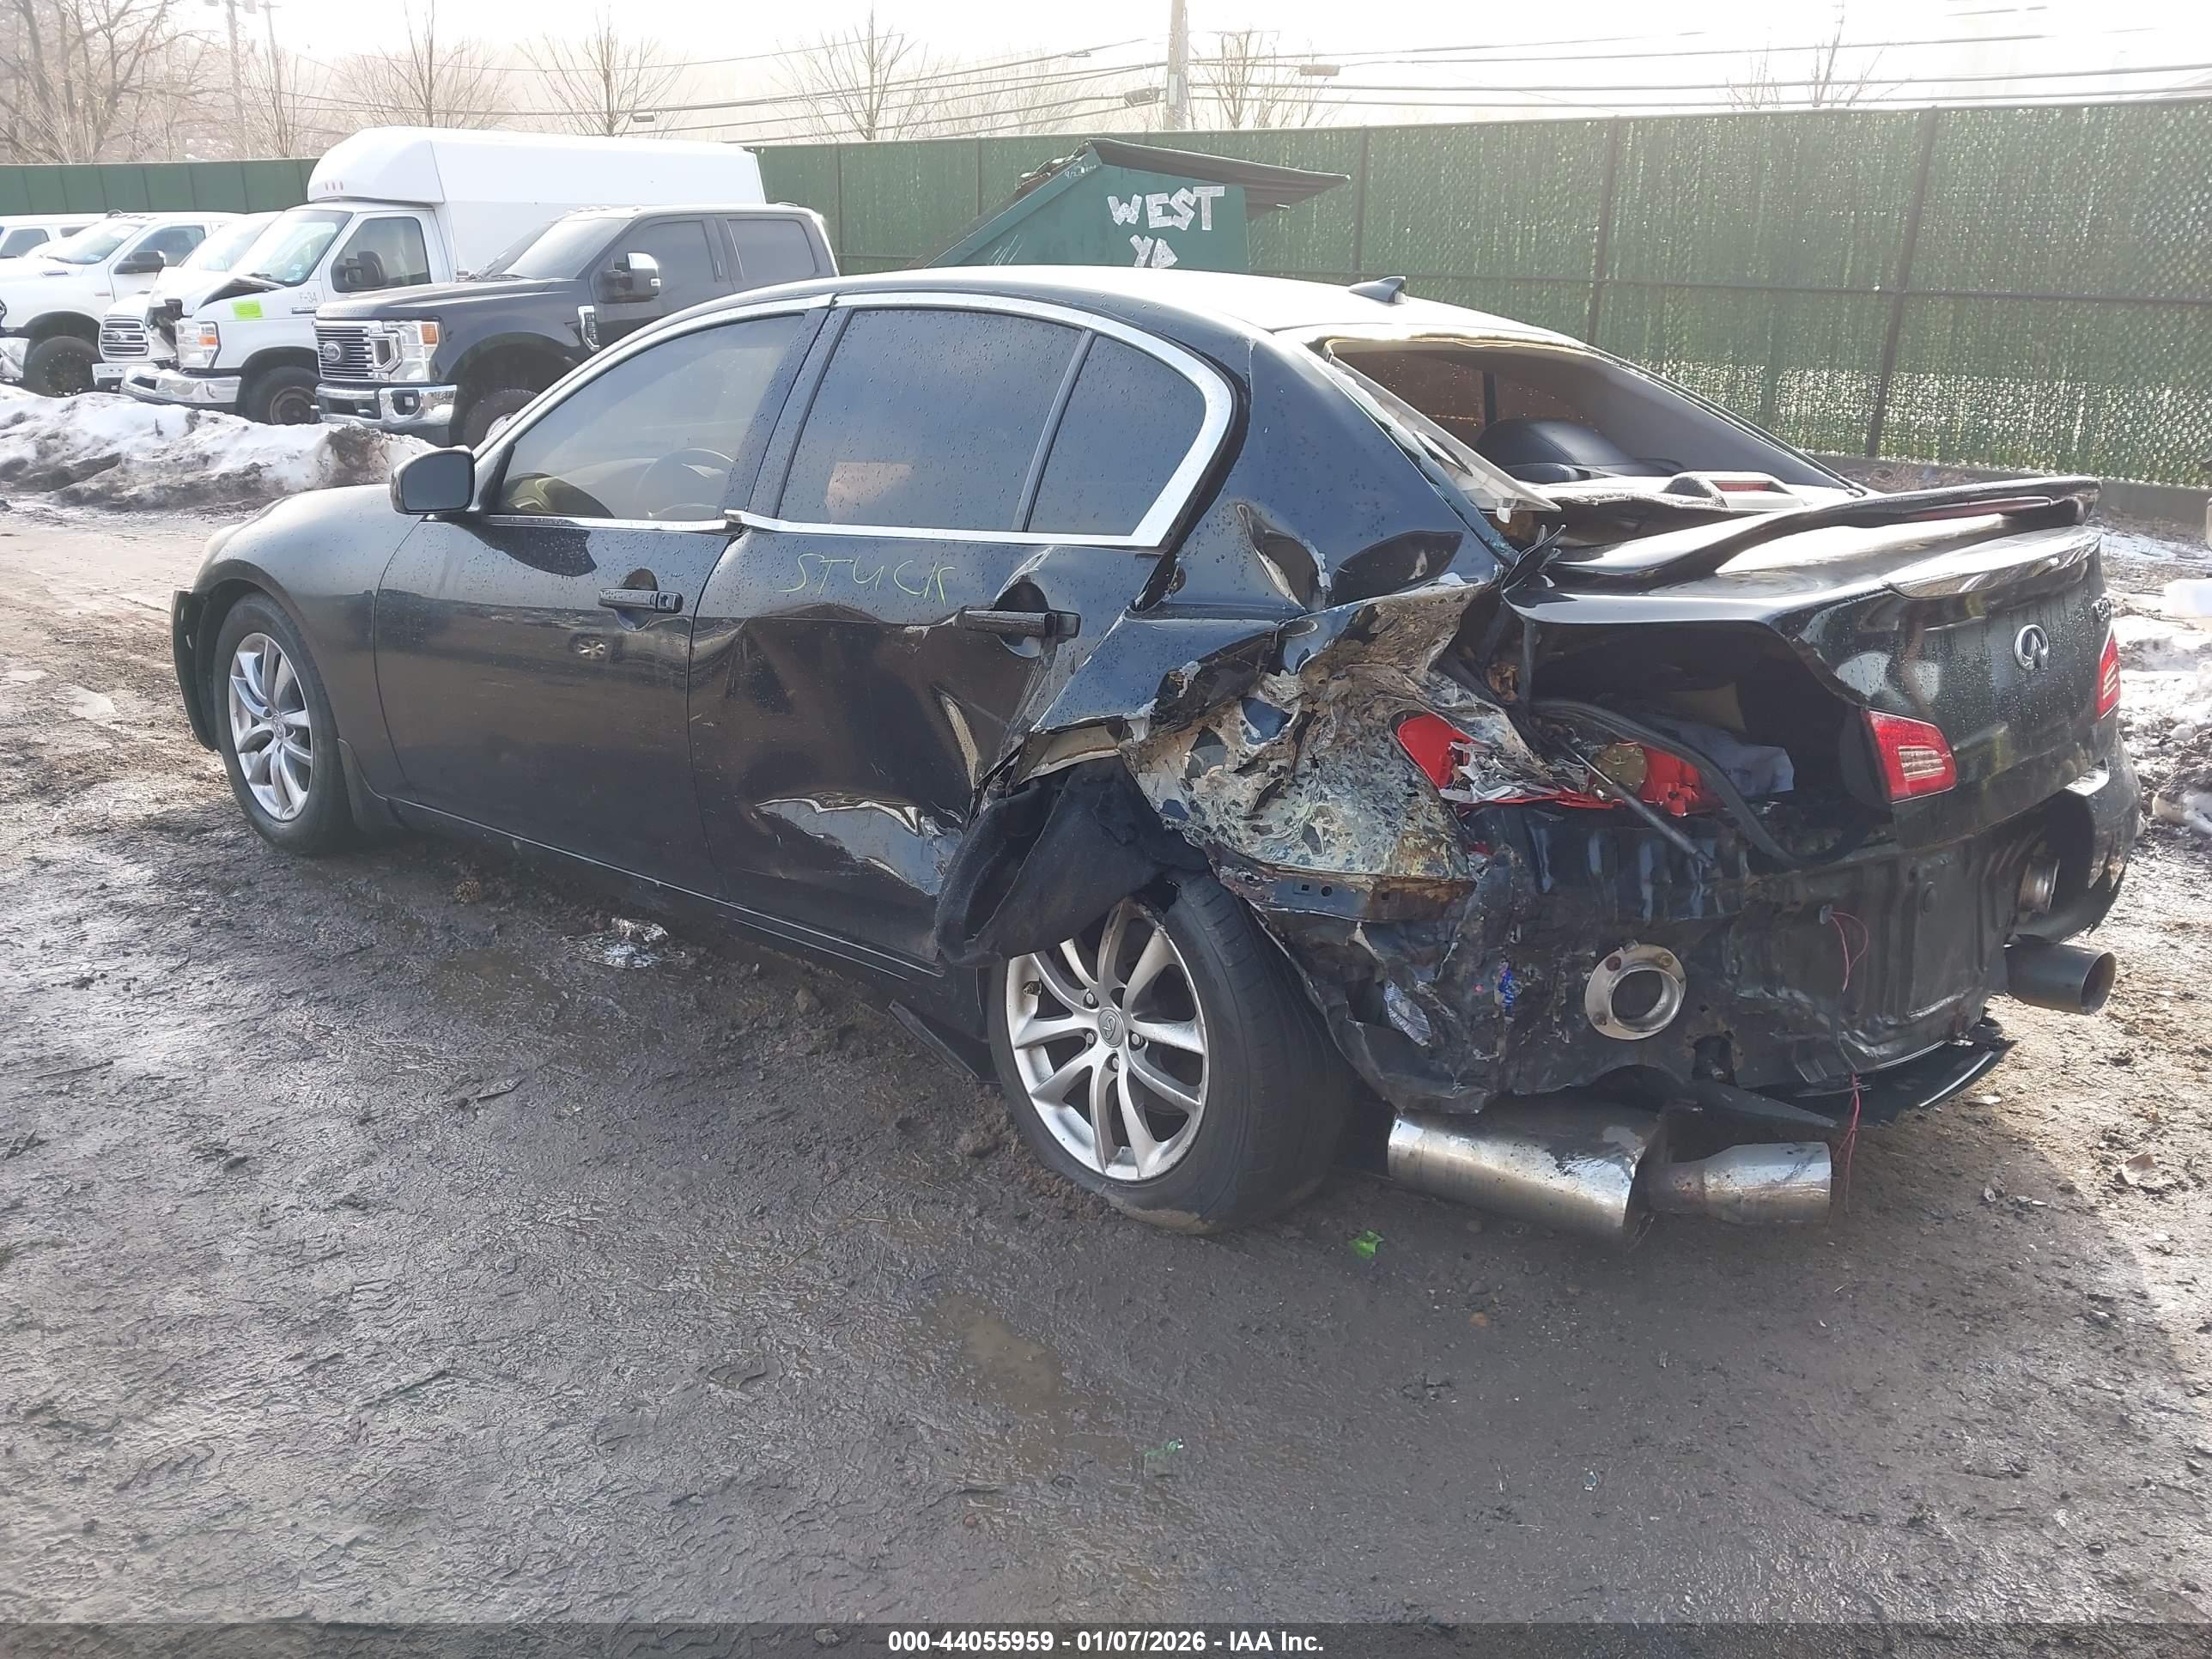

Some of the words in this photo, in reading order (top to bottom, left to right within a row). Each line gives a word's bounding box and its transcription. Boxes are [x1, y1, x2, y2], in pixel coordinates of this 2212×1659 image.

[1107, 185, 1225, 231] WEST
[1129, 234, 1178, 269] YD
[778, 552, 956, 607] STUCK
